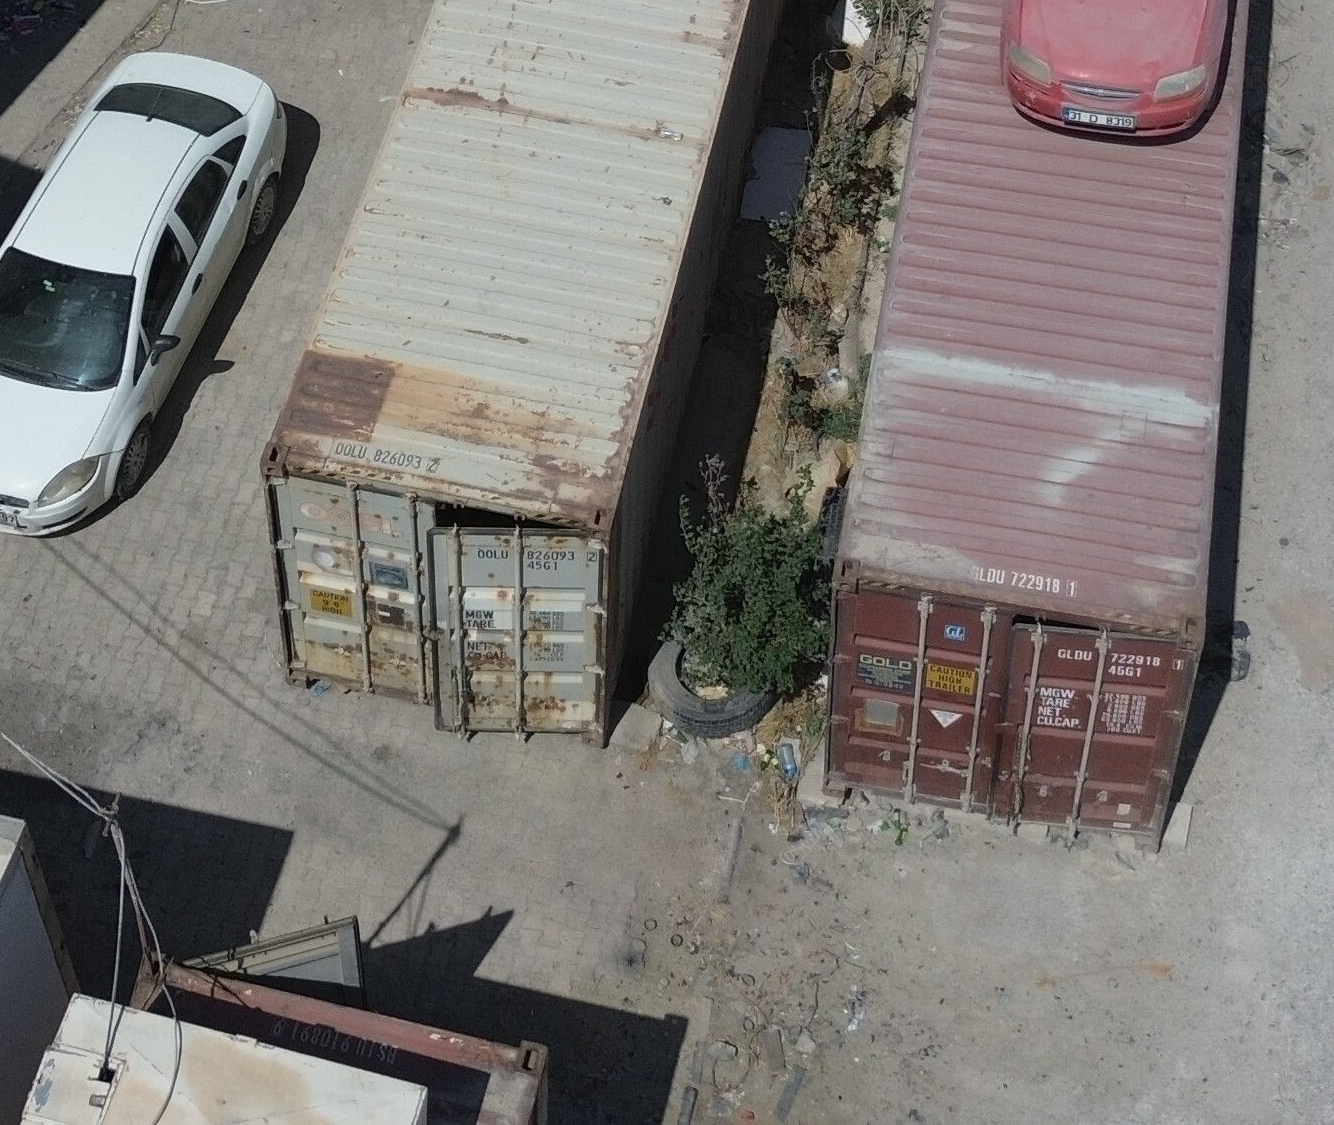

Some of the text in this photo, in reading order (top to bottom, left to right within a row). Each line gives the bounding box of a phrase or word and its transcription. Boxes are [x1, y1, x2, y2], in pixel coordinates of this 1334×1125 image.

[1069, 111, 1132, 127] 31 D 8319
[373, 448, 423, 469] 826093
[526, 550, 575, 561] 826093
[526, 561, 558, 571] 45G1
[1011, 571, 1061, 594] 722918
[465, 610, 495, 619] MGW
[466, 619, 496, 629] TARE
[859, 653, 912, 671] GOLD
[1057, 649, 1093, 662] GLDU
[1110, 652, 1161, 667] 722918
[930, 664, 972, 678] CAUTION
[929, 680, 971, 694] TRAILER
